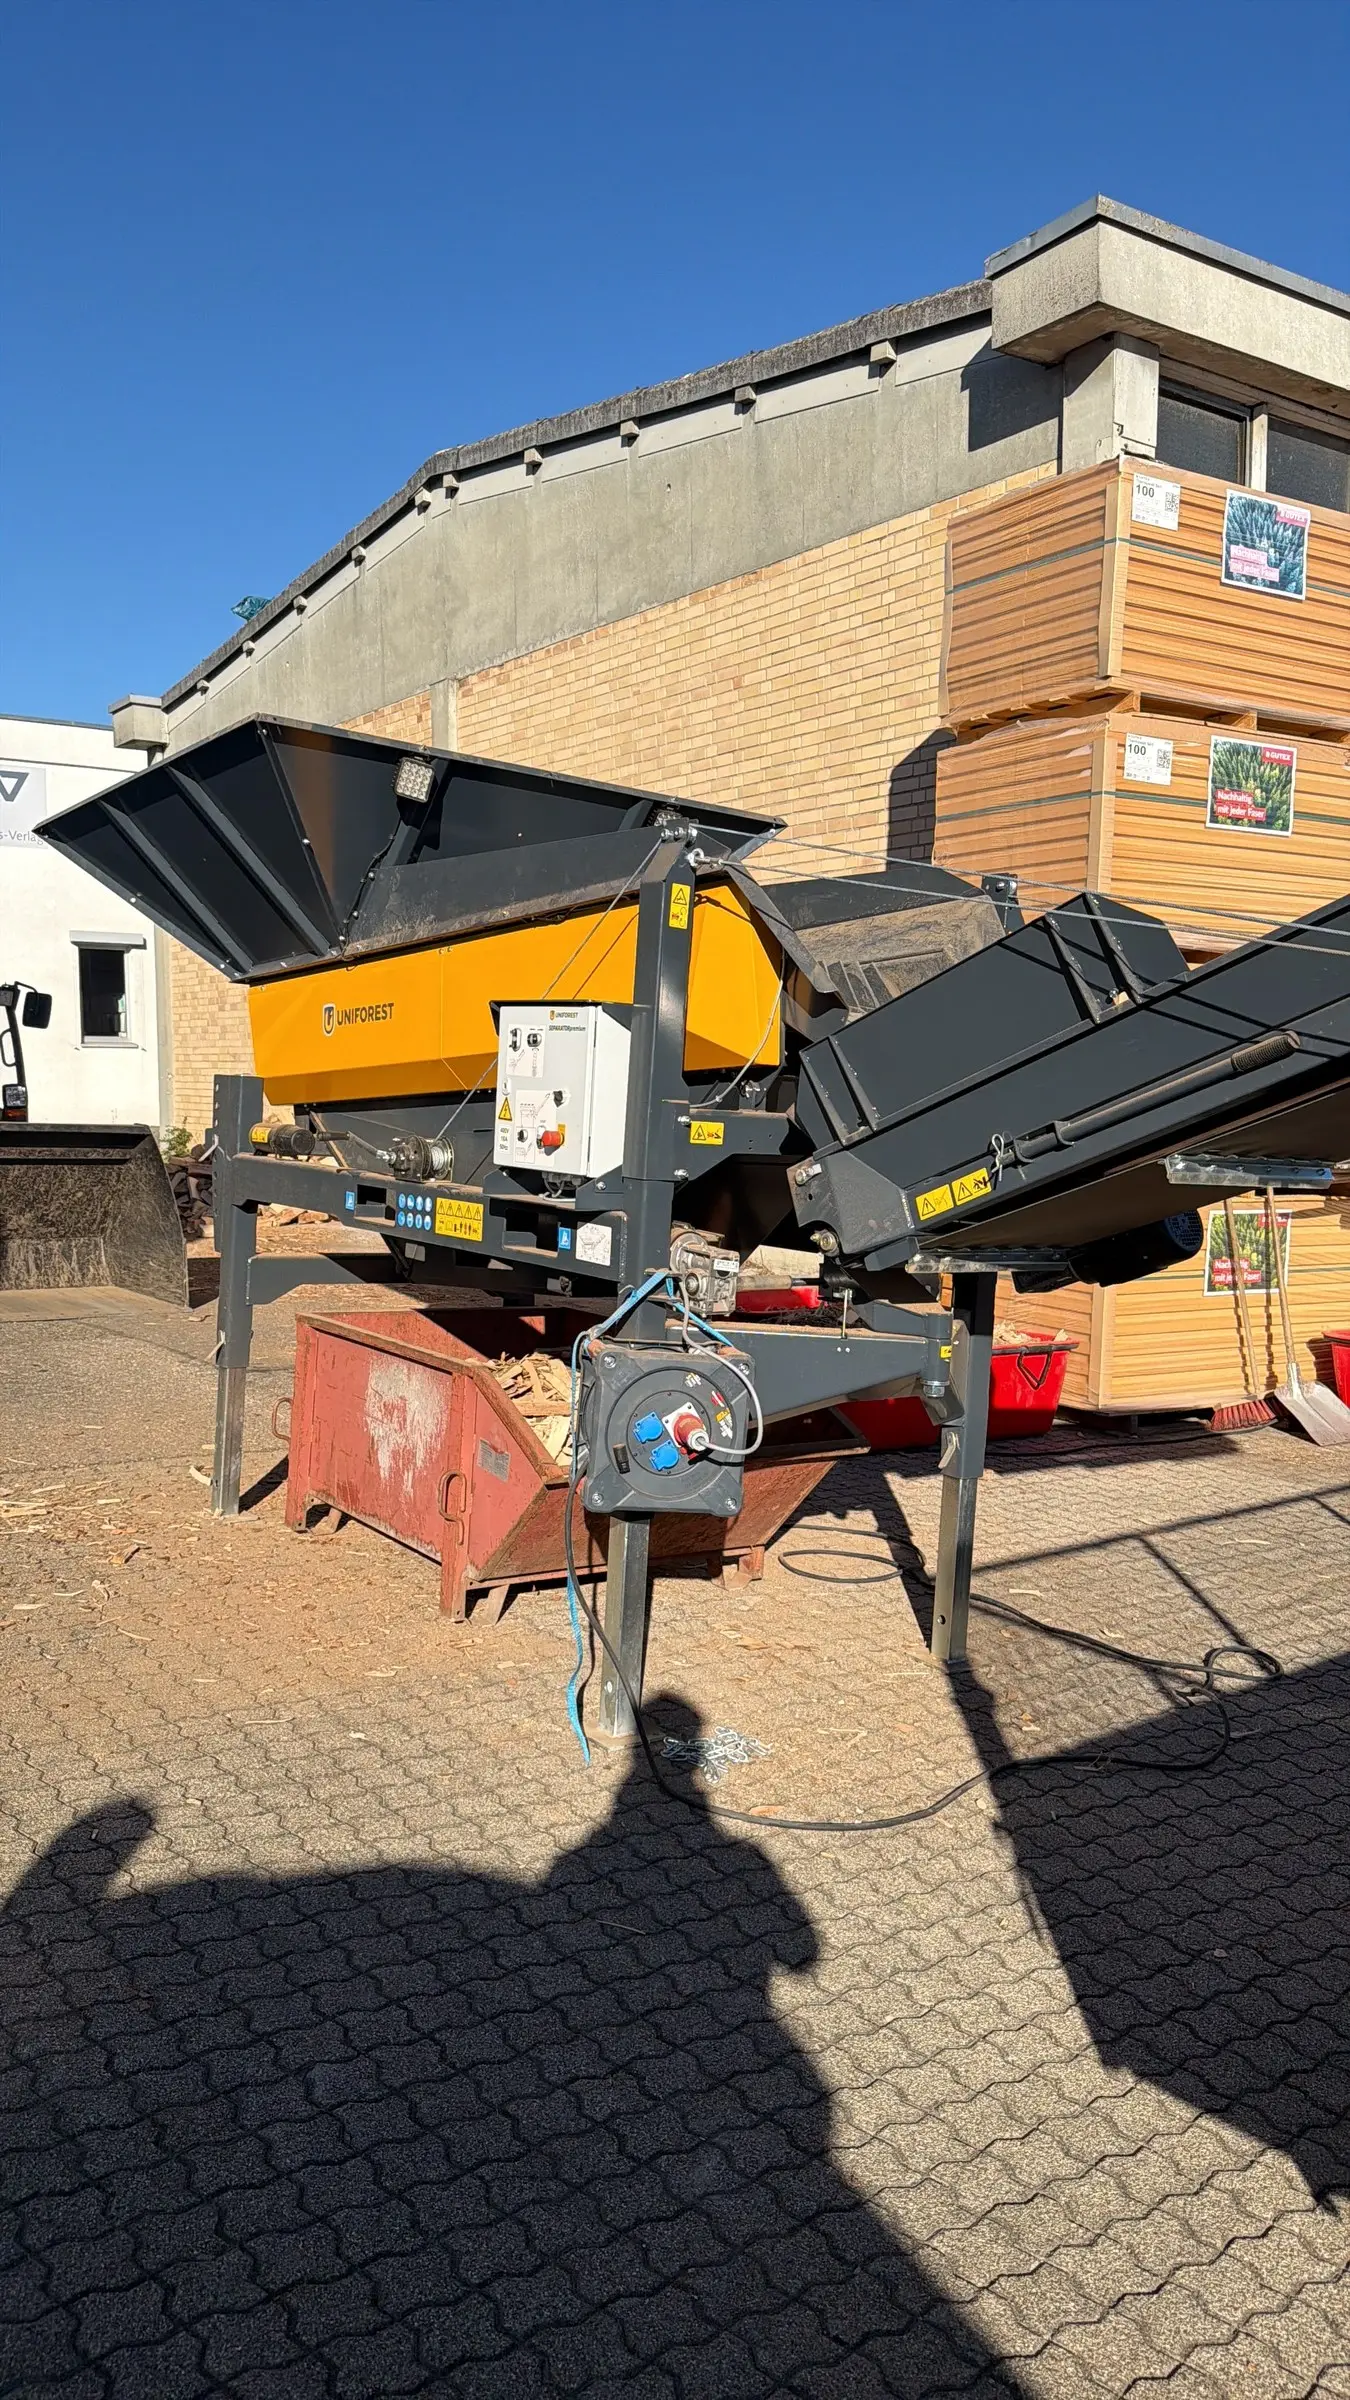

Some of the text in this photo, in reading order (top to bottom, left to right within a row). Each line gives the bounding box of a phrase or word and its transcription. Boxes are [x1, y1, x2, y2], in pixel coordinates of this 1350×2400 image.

[1136, 484, 1155, 498] 100
[1128, 744, 1146, 756] 100
[1270, 751, 1291, 761] GUTEX
[1217, 790, 1253, 804] Nachhaltig
[1217, 804, 1265, 818] mit jeder Faser
[337, 1002, 394, 1026] UNIFOREST
[1215, 1272, 1226, 1281] mit
[1243, 1272, 1260, 1281] Faser
